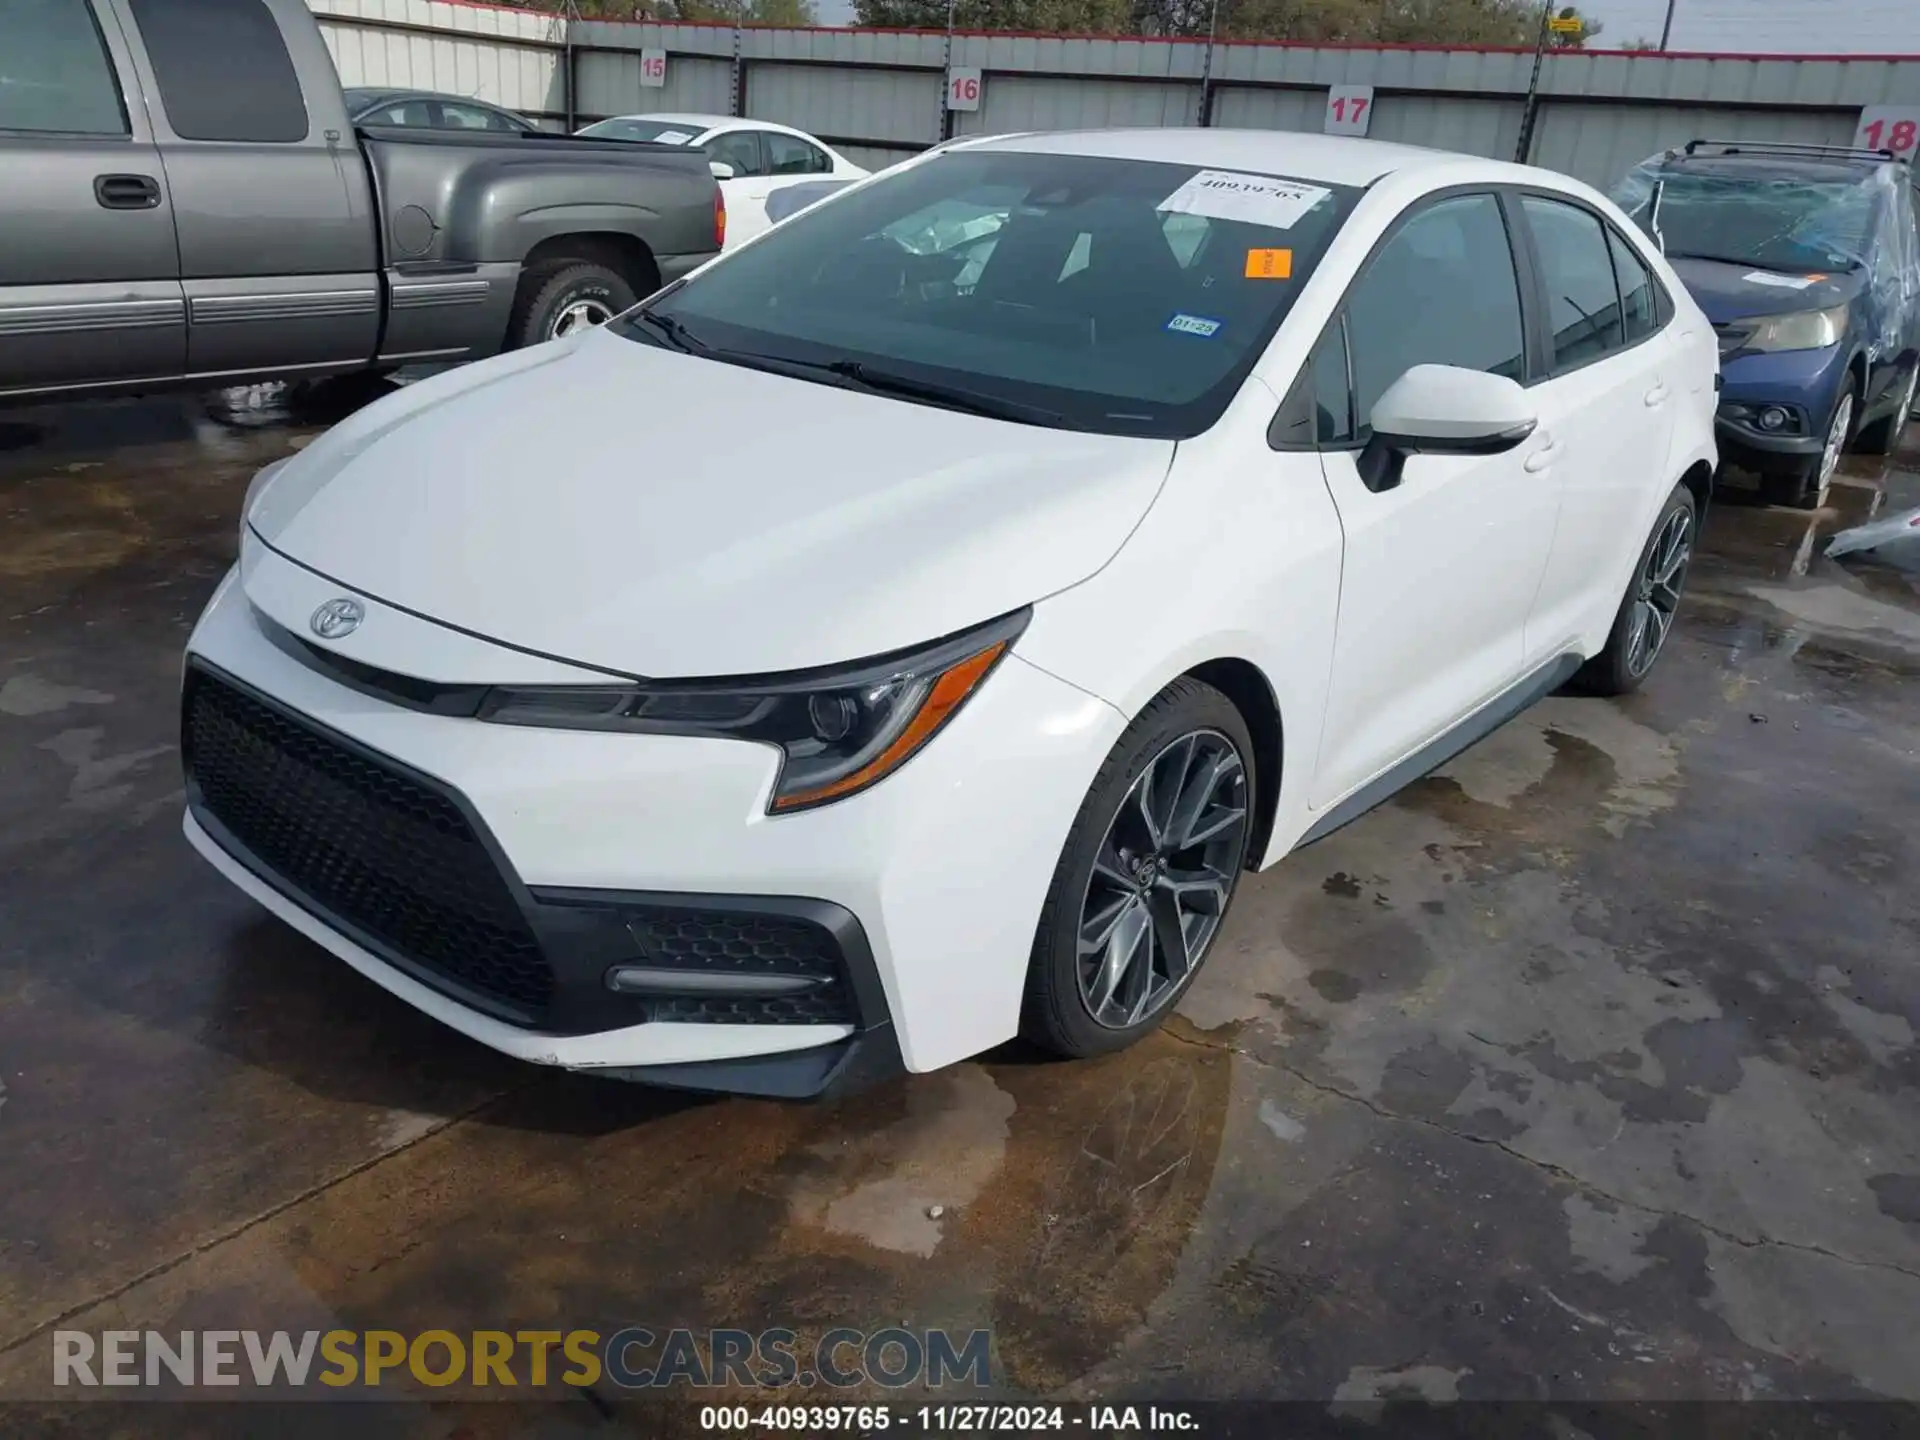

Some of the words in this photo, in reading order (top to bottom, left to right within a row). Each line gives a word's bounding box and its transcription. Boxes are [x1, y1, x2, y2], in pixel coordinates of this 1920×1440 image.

[643, 58, 663, 77] 15
[952, 78, 978, 100] 16
[1332, 97, 1369, 123] 17
[1863, 119, 1916, 151] 18
